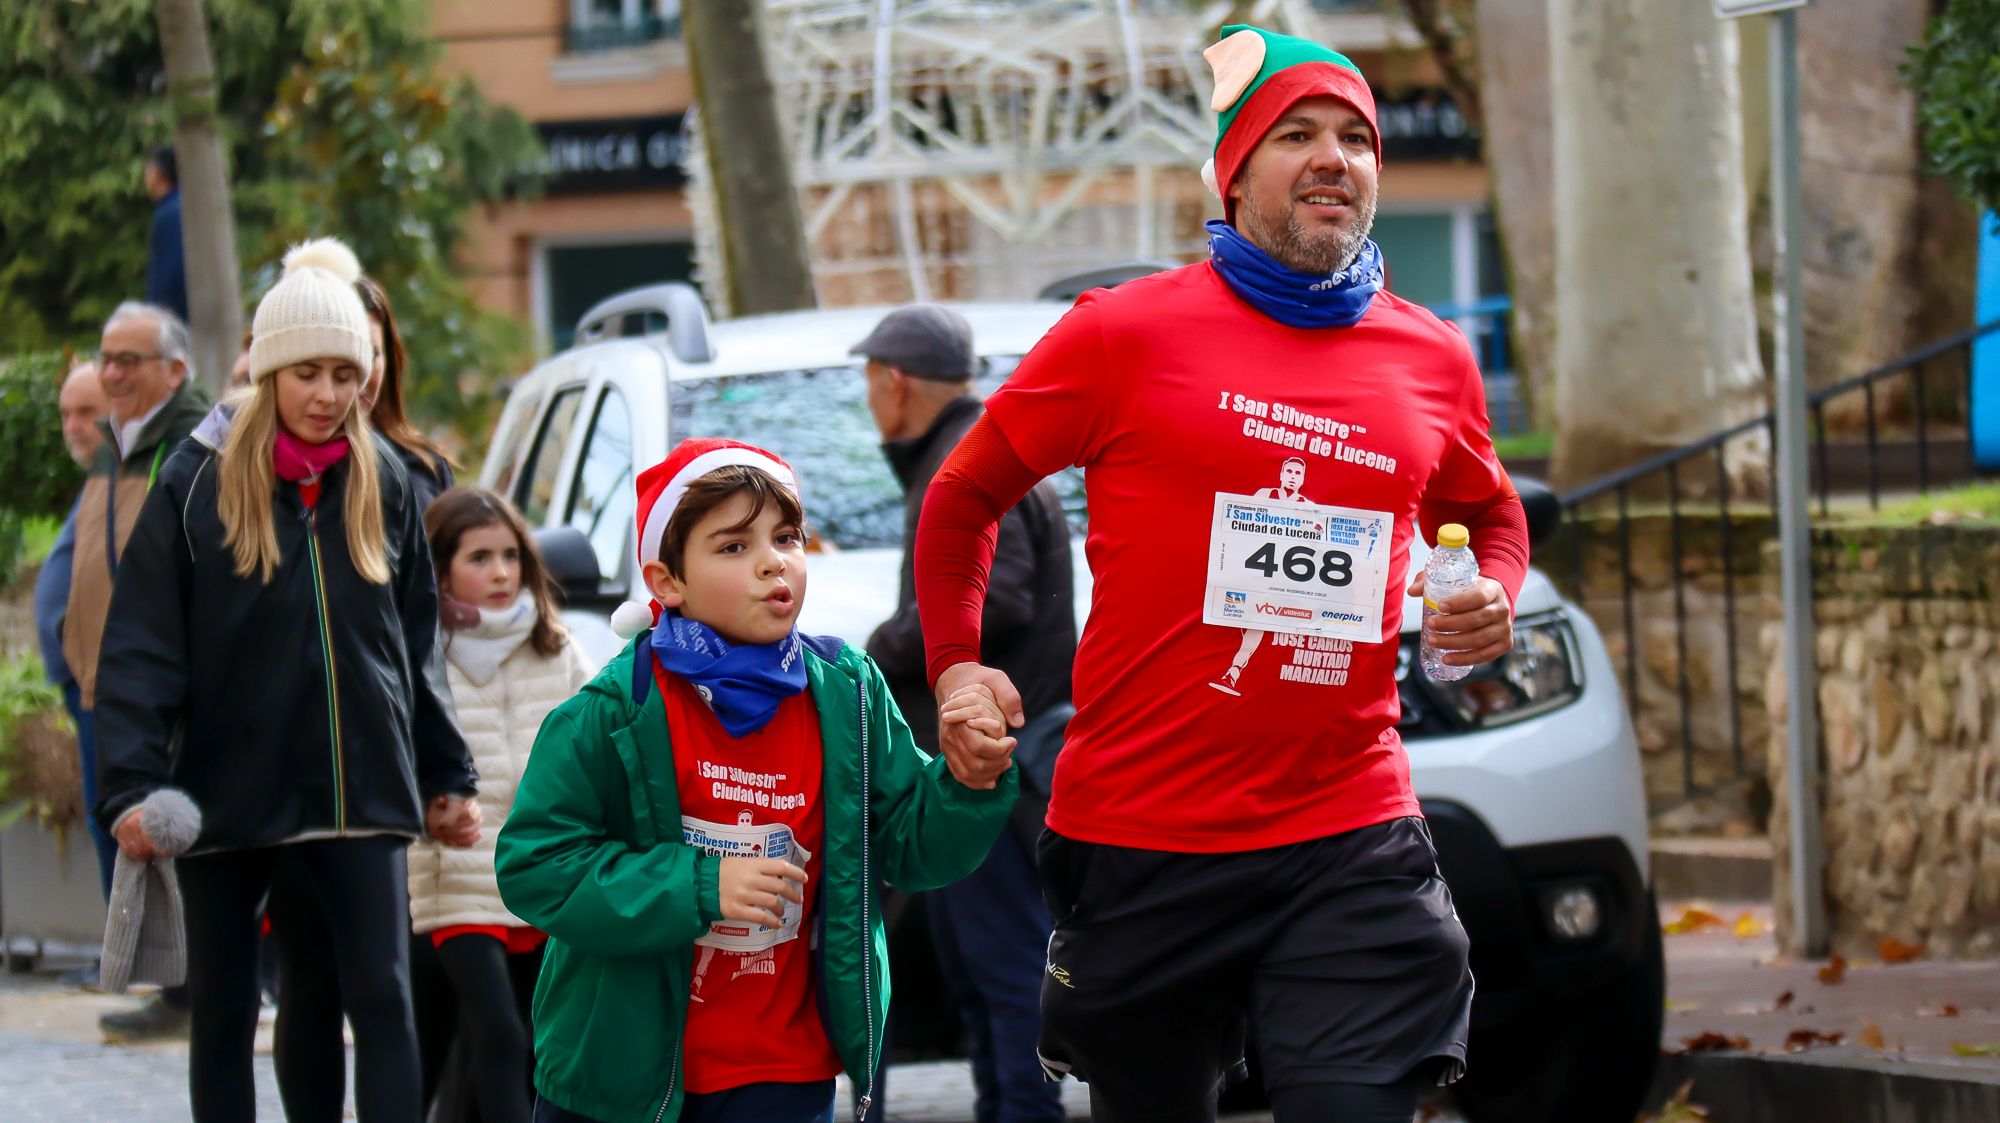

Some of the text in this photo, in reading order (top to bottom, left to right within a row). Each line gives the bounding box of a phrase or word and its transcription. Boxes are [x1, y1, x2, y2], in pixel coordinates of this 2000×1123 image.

[1218, 391, 1230, 410] I
[1232, 393, 1269, 418] San
[1271, 402, 1350, 440] Silvestre
[1242, 417, 1397, 475] Ciudad de Lucena
[1226, 508, 1232, 518] I
[1233, 509, 1252, 521] San
[1255, 512, 1301, 527] Silvestre
[1331, 517, 1361, 526] MEMORIAL
[1231, 520, 1321, 541] Ciudad de Lucena
[1244, 542, 1353, 588] 468
[1283, 609, 1311, 618] videoluc
[1321, 610, 1364, 622] enerplus
[1293, 648, 1351, 670] HURTADO
[1280, 664, 1349, 686] MARJALIZO
[702, 761, 728, 780] San
[692, 832, 739, 850] Silvestre
